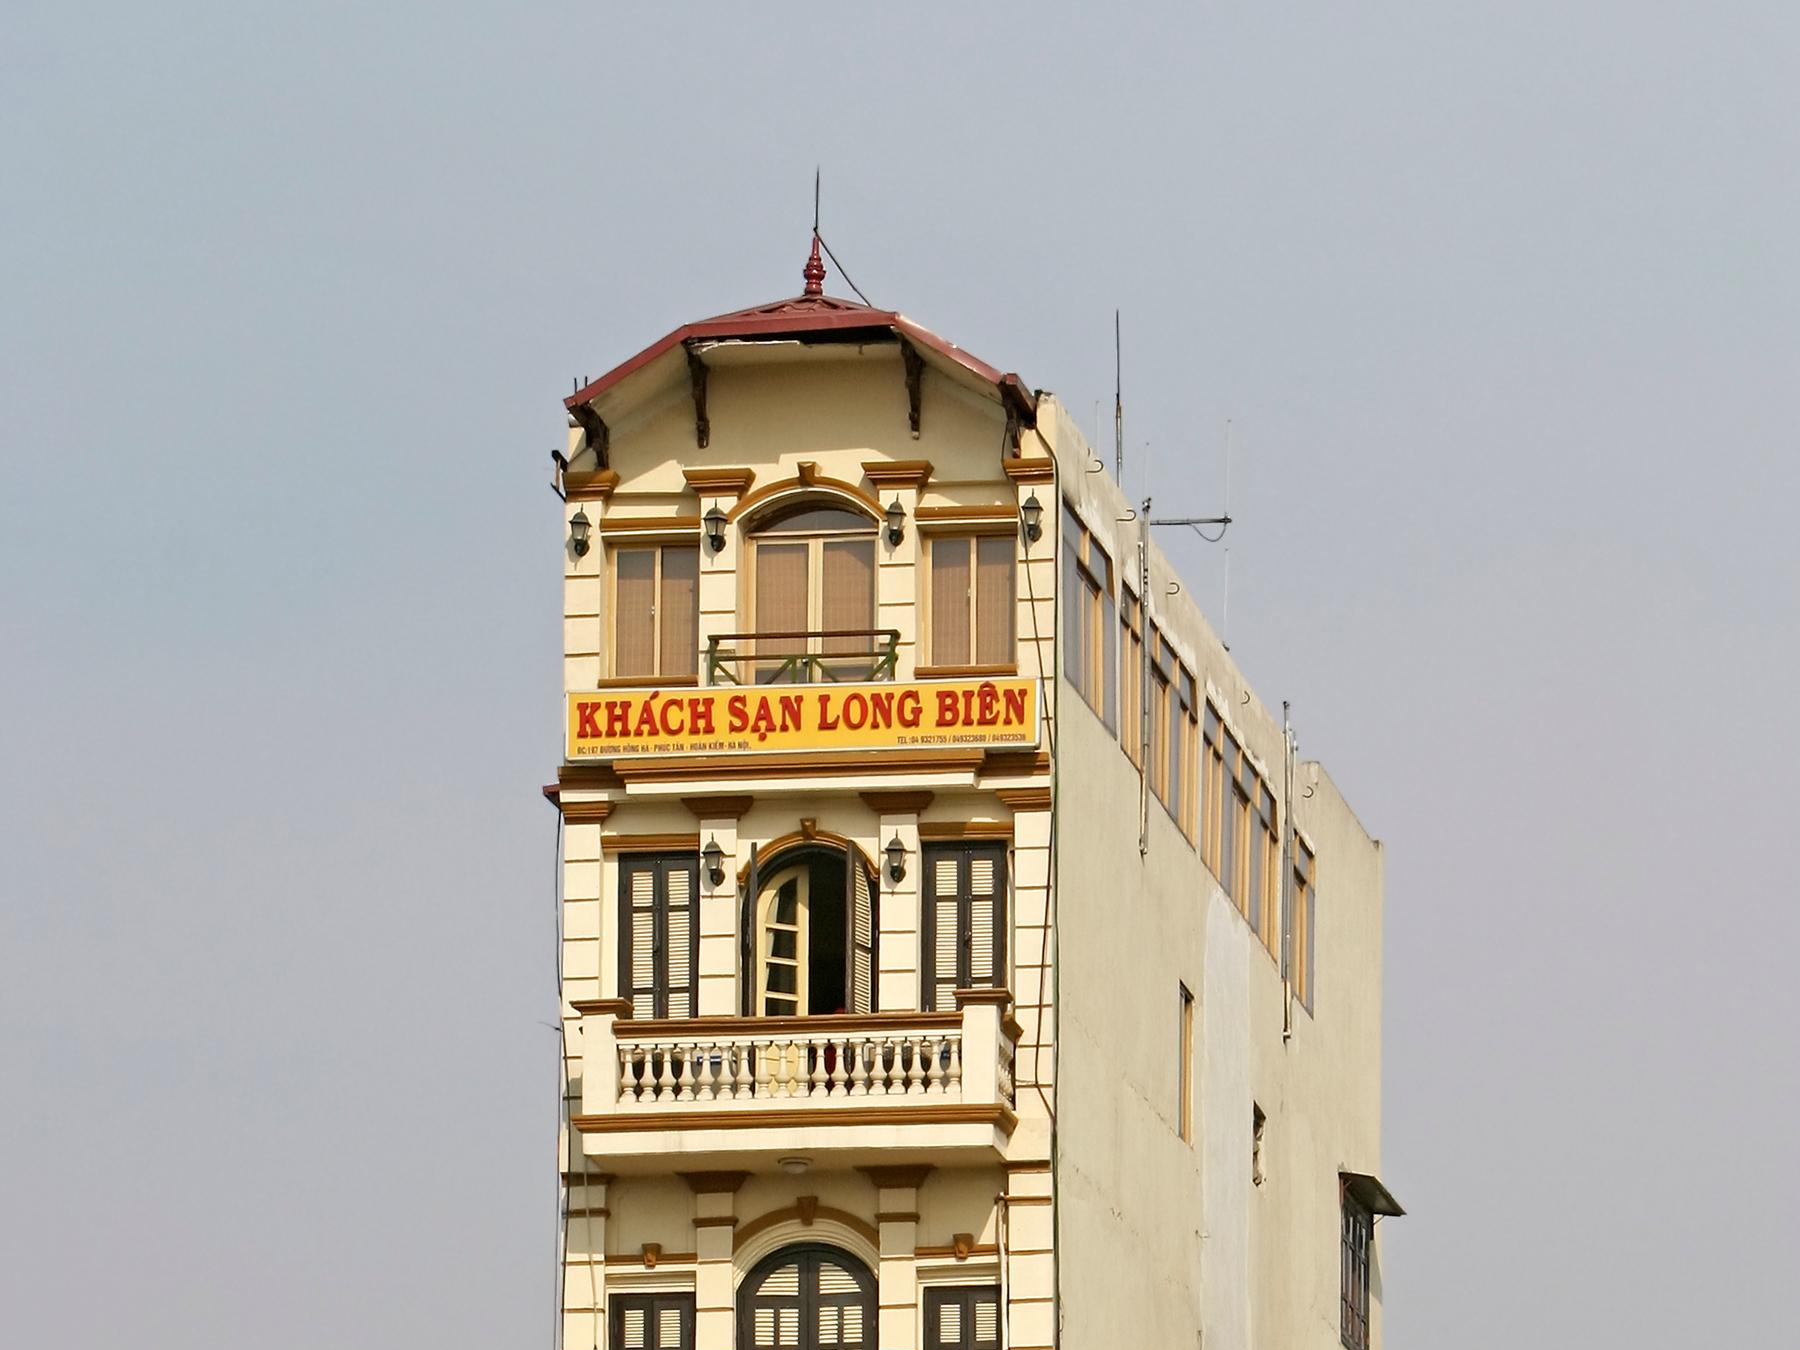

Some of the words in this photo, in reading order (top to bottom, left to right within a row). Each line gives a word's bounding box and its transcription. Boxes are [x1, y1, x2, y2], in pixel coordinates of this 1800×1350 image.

[576, 691, 715, 738] KHÁCH
[728, 694, 804, 742] SẠN
[818, 690, 923, 731] LONG
[935, 681, 1029, 726] BIÊN
